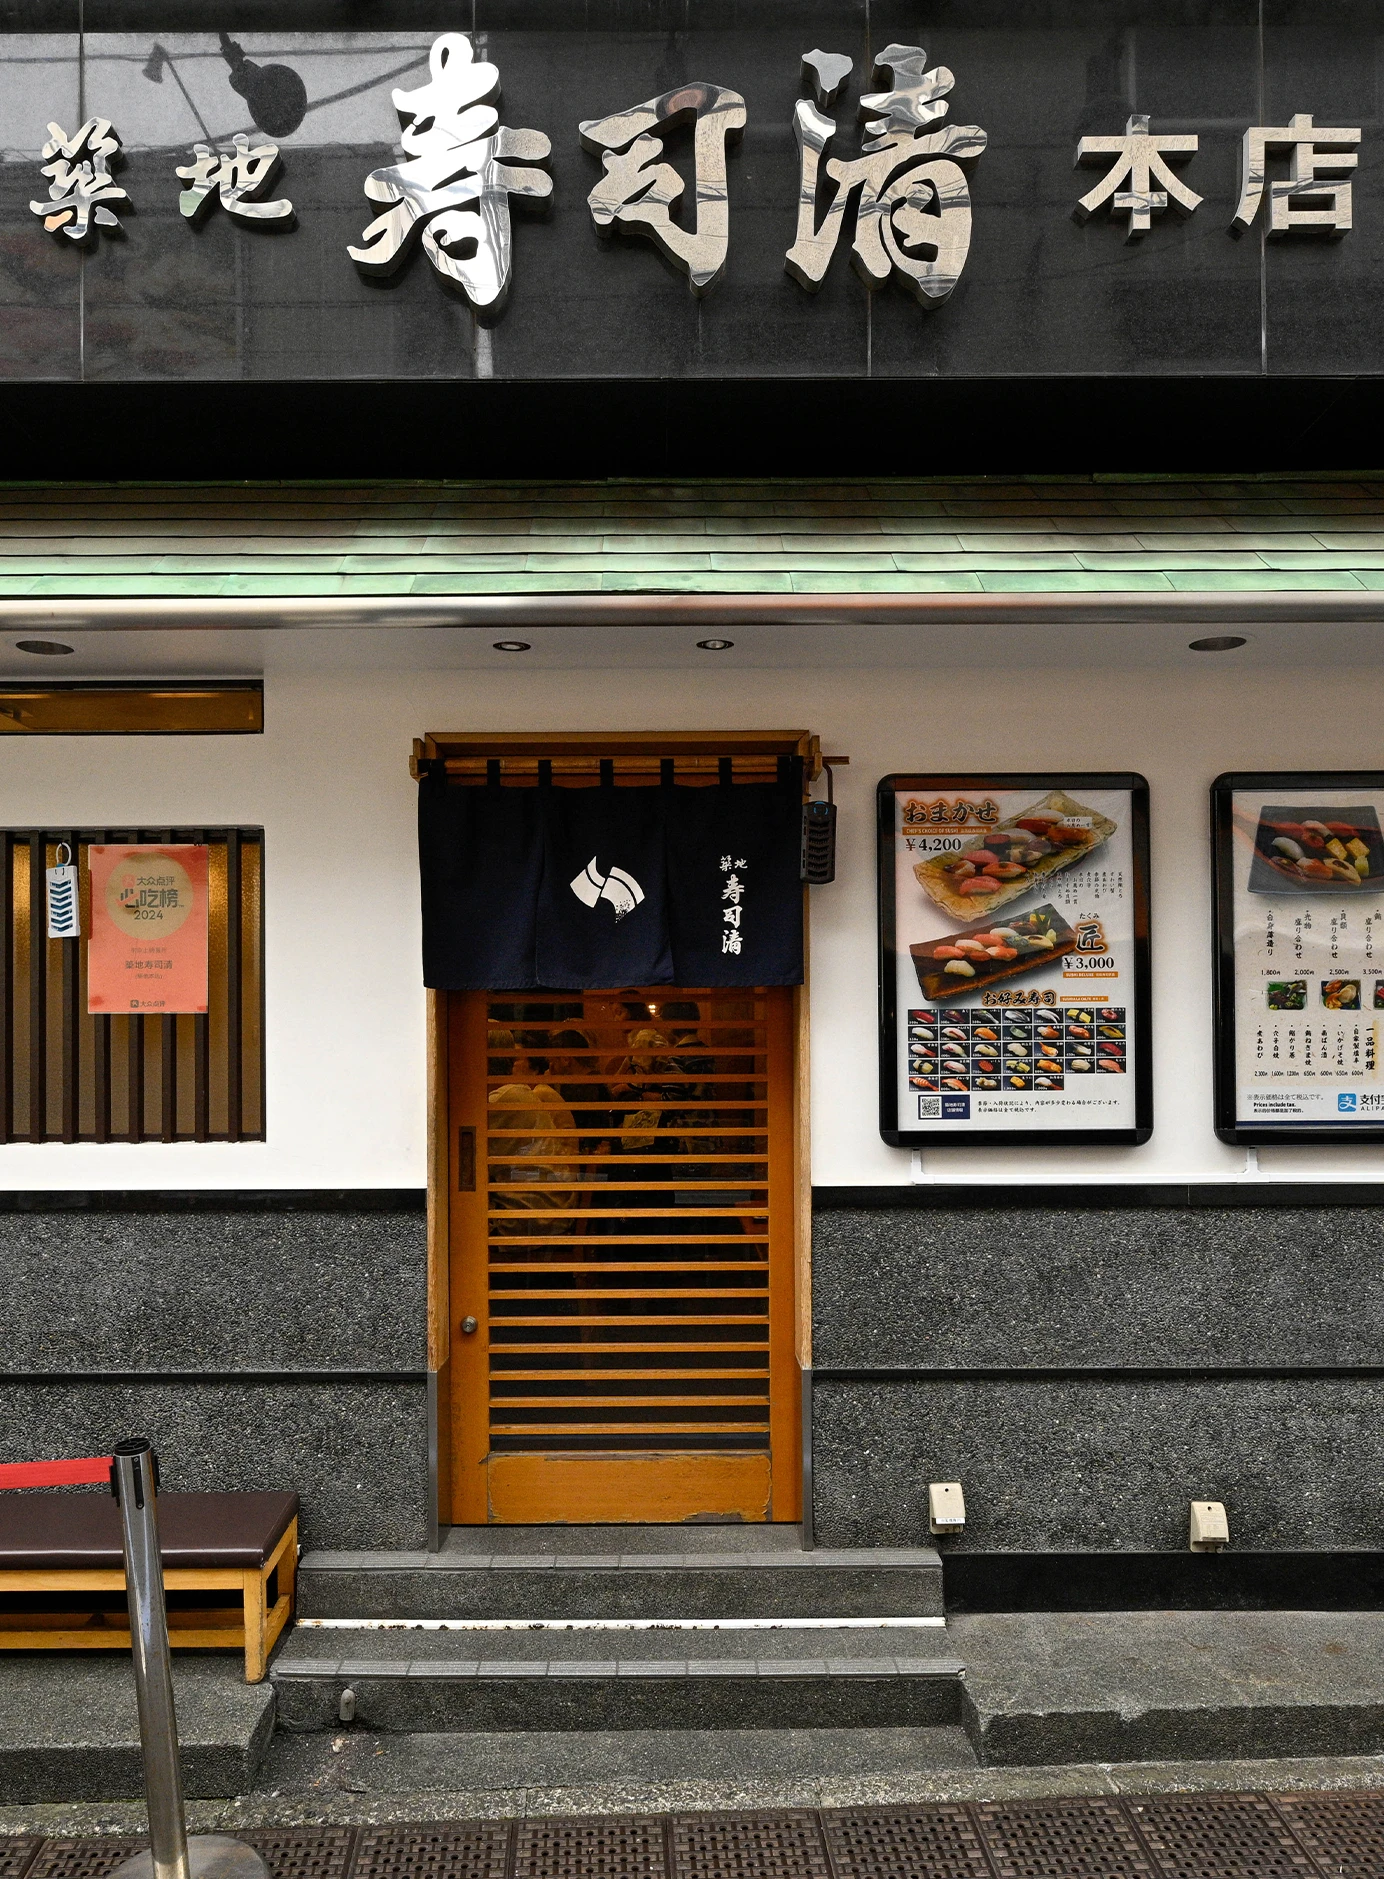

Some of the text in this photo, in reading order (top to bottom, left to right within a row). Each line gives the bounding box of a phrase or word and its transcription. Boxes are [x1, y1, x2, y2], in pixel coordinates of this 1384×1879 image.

[1075, 113, 1363, 231] 本店
[905, 800, 998, 823] おまかせ
[719, 855, 748, 872] 築地
[136, 876, 175, 887] 大众点评
[134, 910, 164, 920] 2024
[721, 873, 745, 955] 寿司清
[1079, 912, 1100, 920] たくみ
[1076, 923, 1105, 952] 匠
[1294, 918, 1303, 959] 盛り合わせ
[1330, 917, 1338, 959] 盛り合わせ
[1364, 917, 1373, 959] 盛り合わせ
[984, 990, 1057, 1006] お好み寿司
[1365, 1027, 1375, 1071] 一品料理
